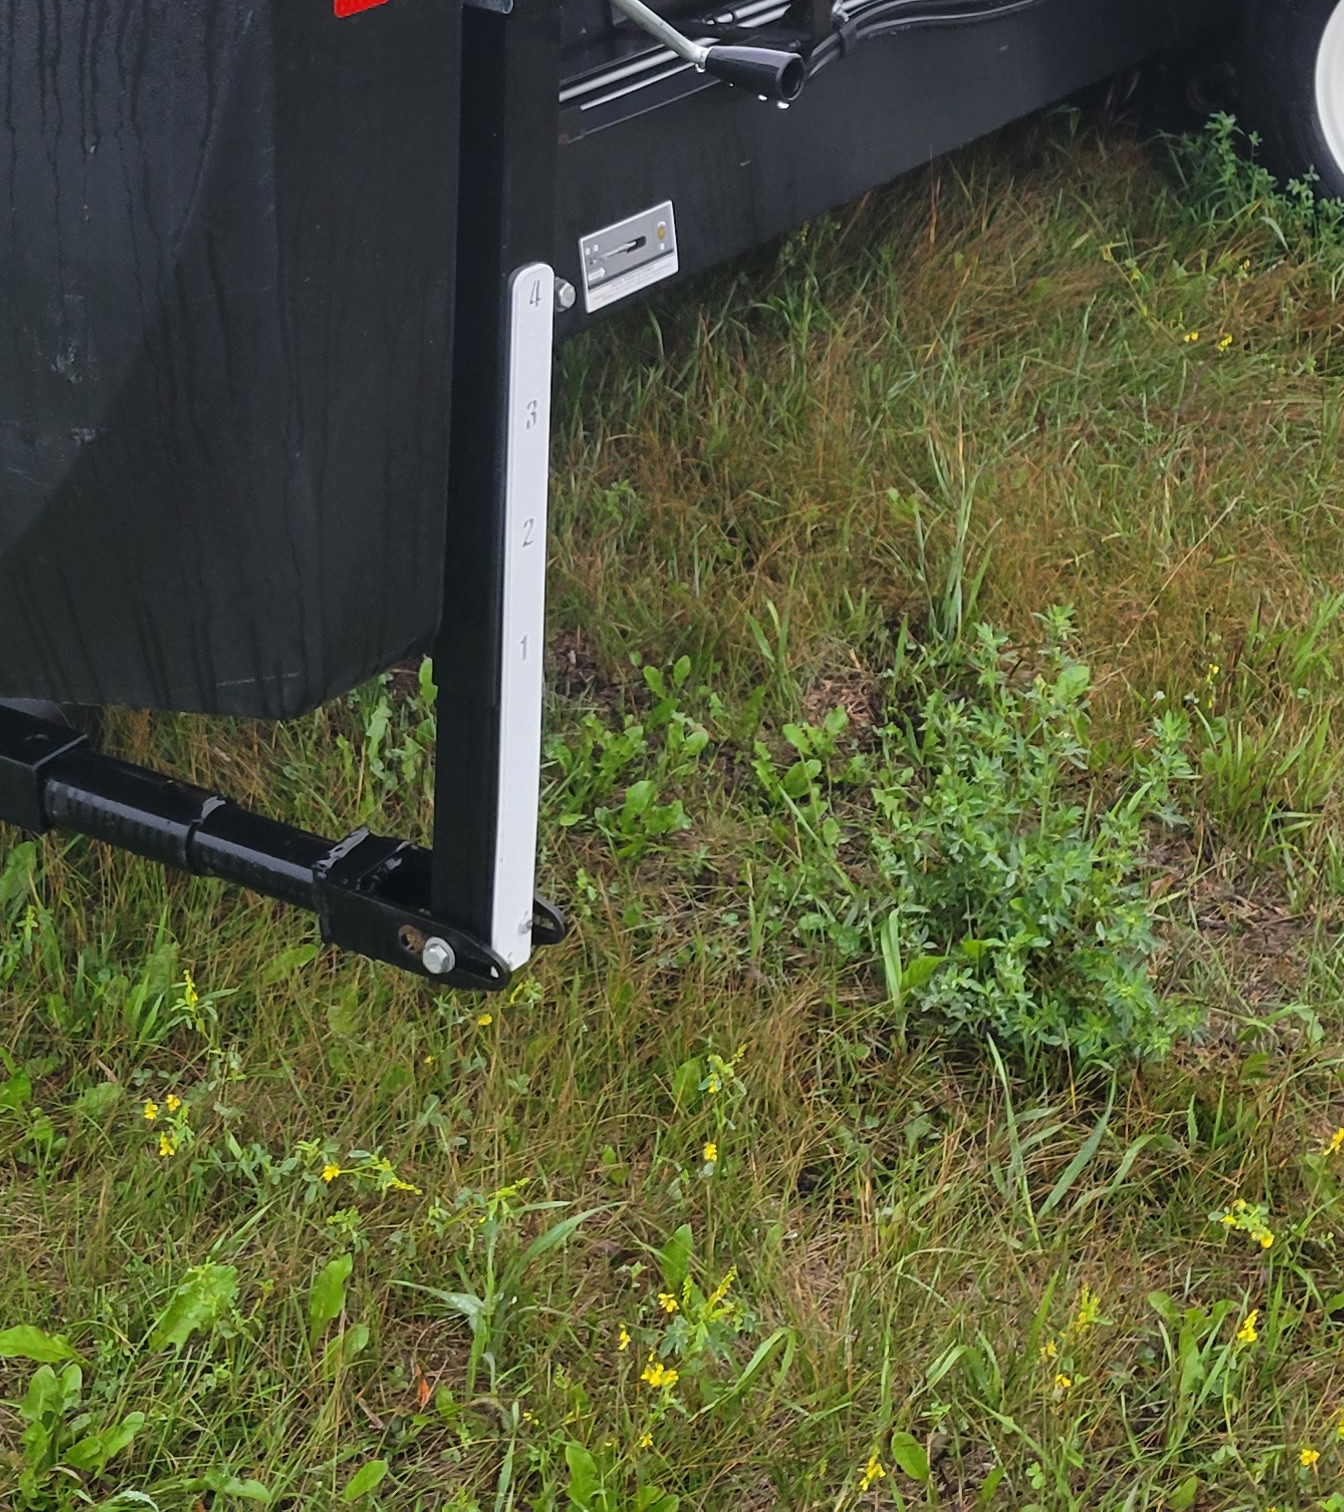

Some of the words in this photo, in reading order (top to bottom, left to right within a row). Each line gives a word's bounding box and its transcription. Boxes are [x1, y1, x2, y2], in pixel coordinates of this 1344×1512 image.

[528, 279, 543, 308] 4
[525, 399, 538, 430] 3
[521, 517, 535, 548] 2
[519, 634, 528, 662] 1
